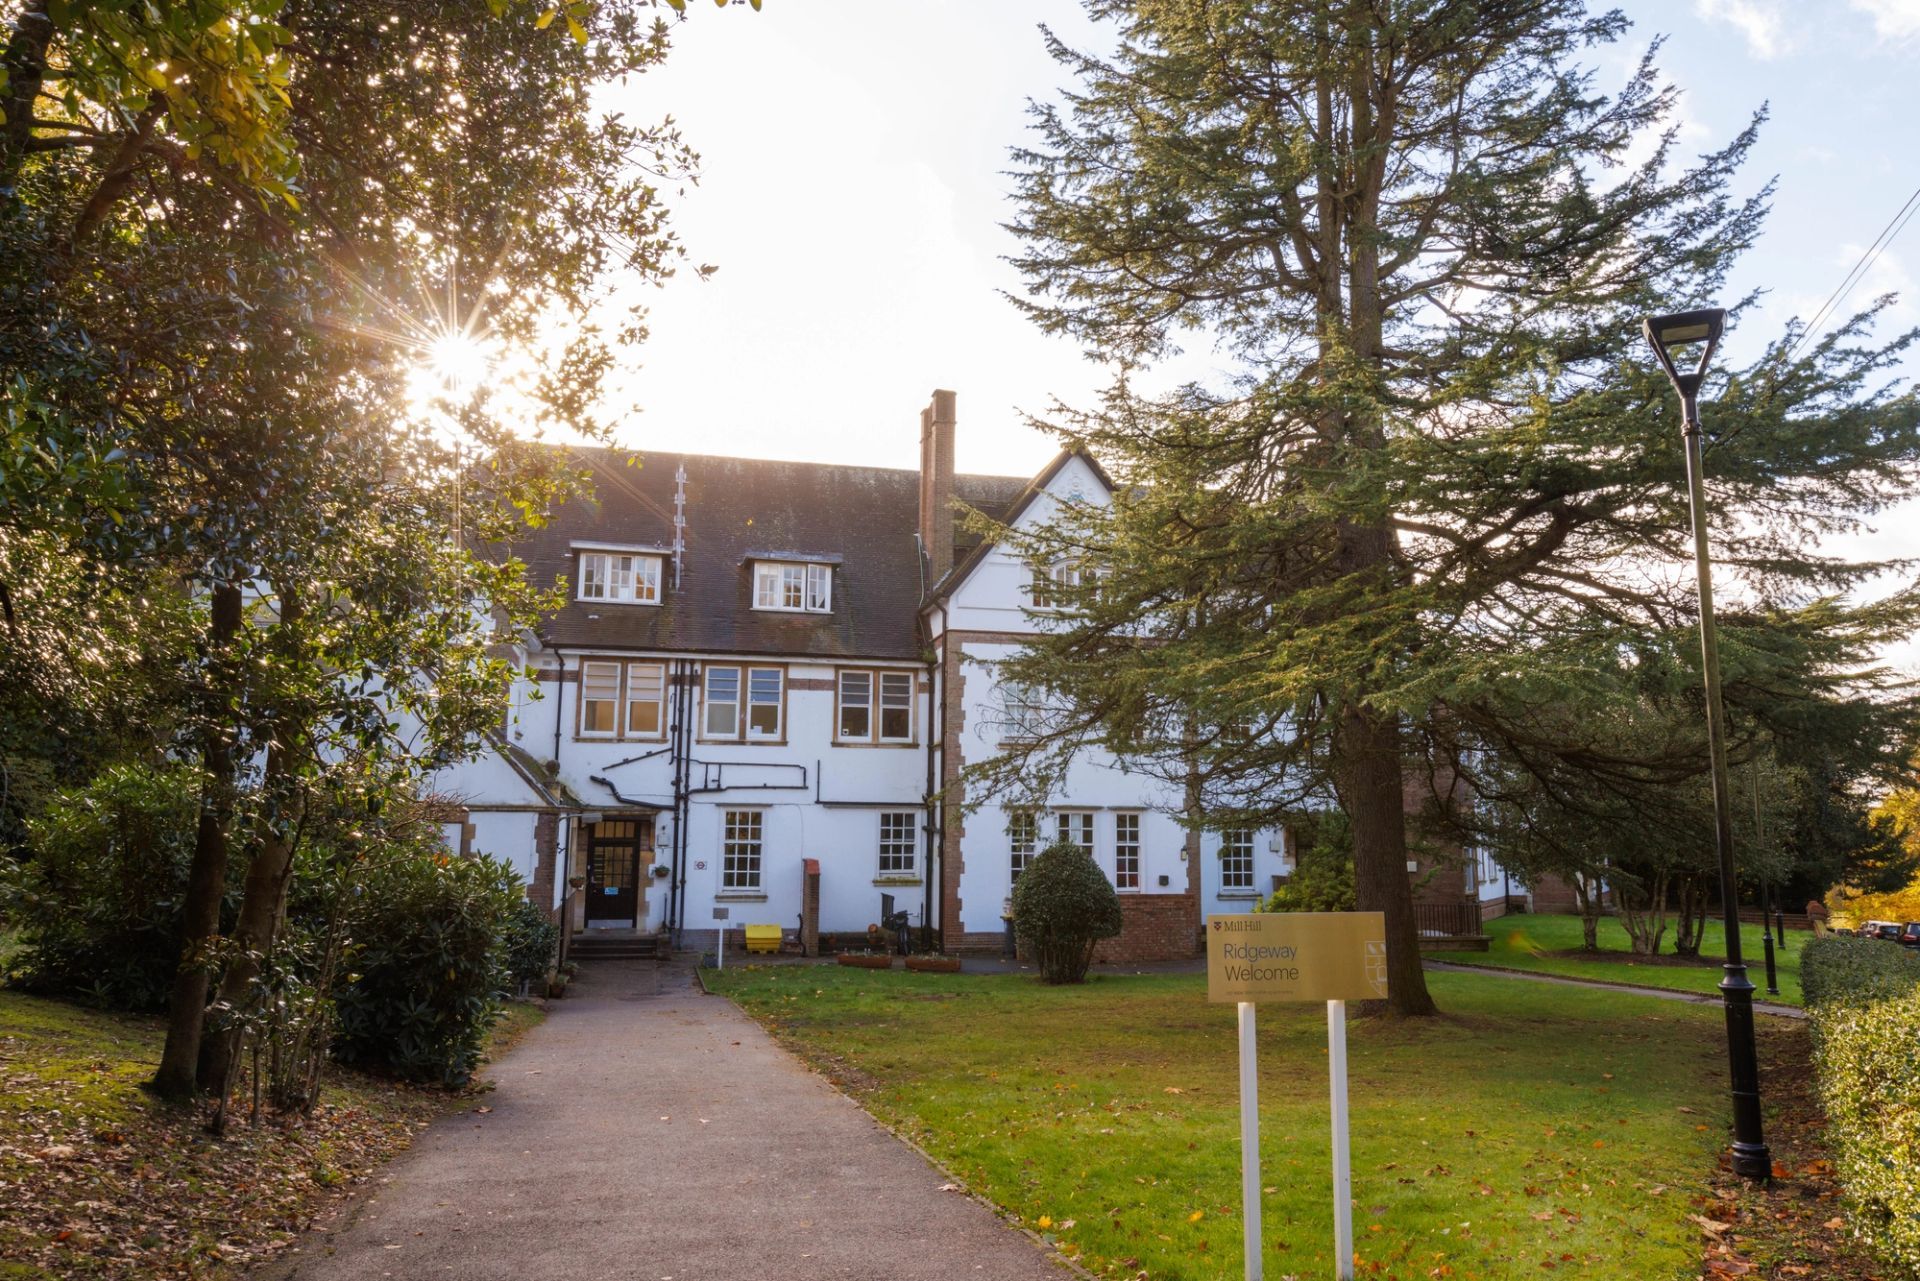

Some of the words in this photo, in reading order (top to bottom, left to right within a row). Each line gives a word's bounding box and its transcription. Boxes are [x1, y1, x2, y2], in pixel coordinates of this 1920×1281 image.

[1224, 920, 1243, 932] Mill
[1244, 920, 1262, 932] Hill
[1224, 942, 1298, 963] Ridgeway
[1224, 964, 1300, 981] Welcome
